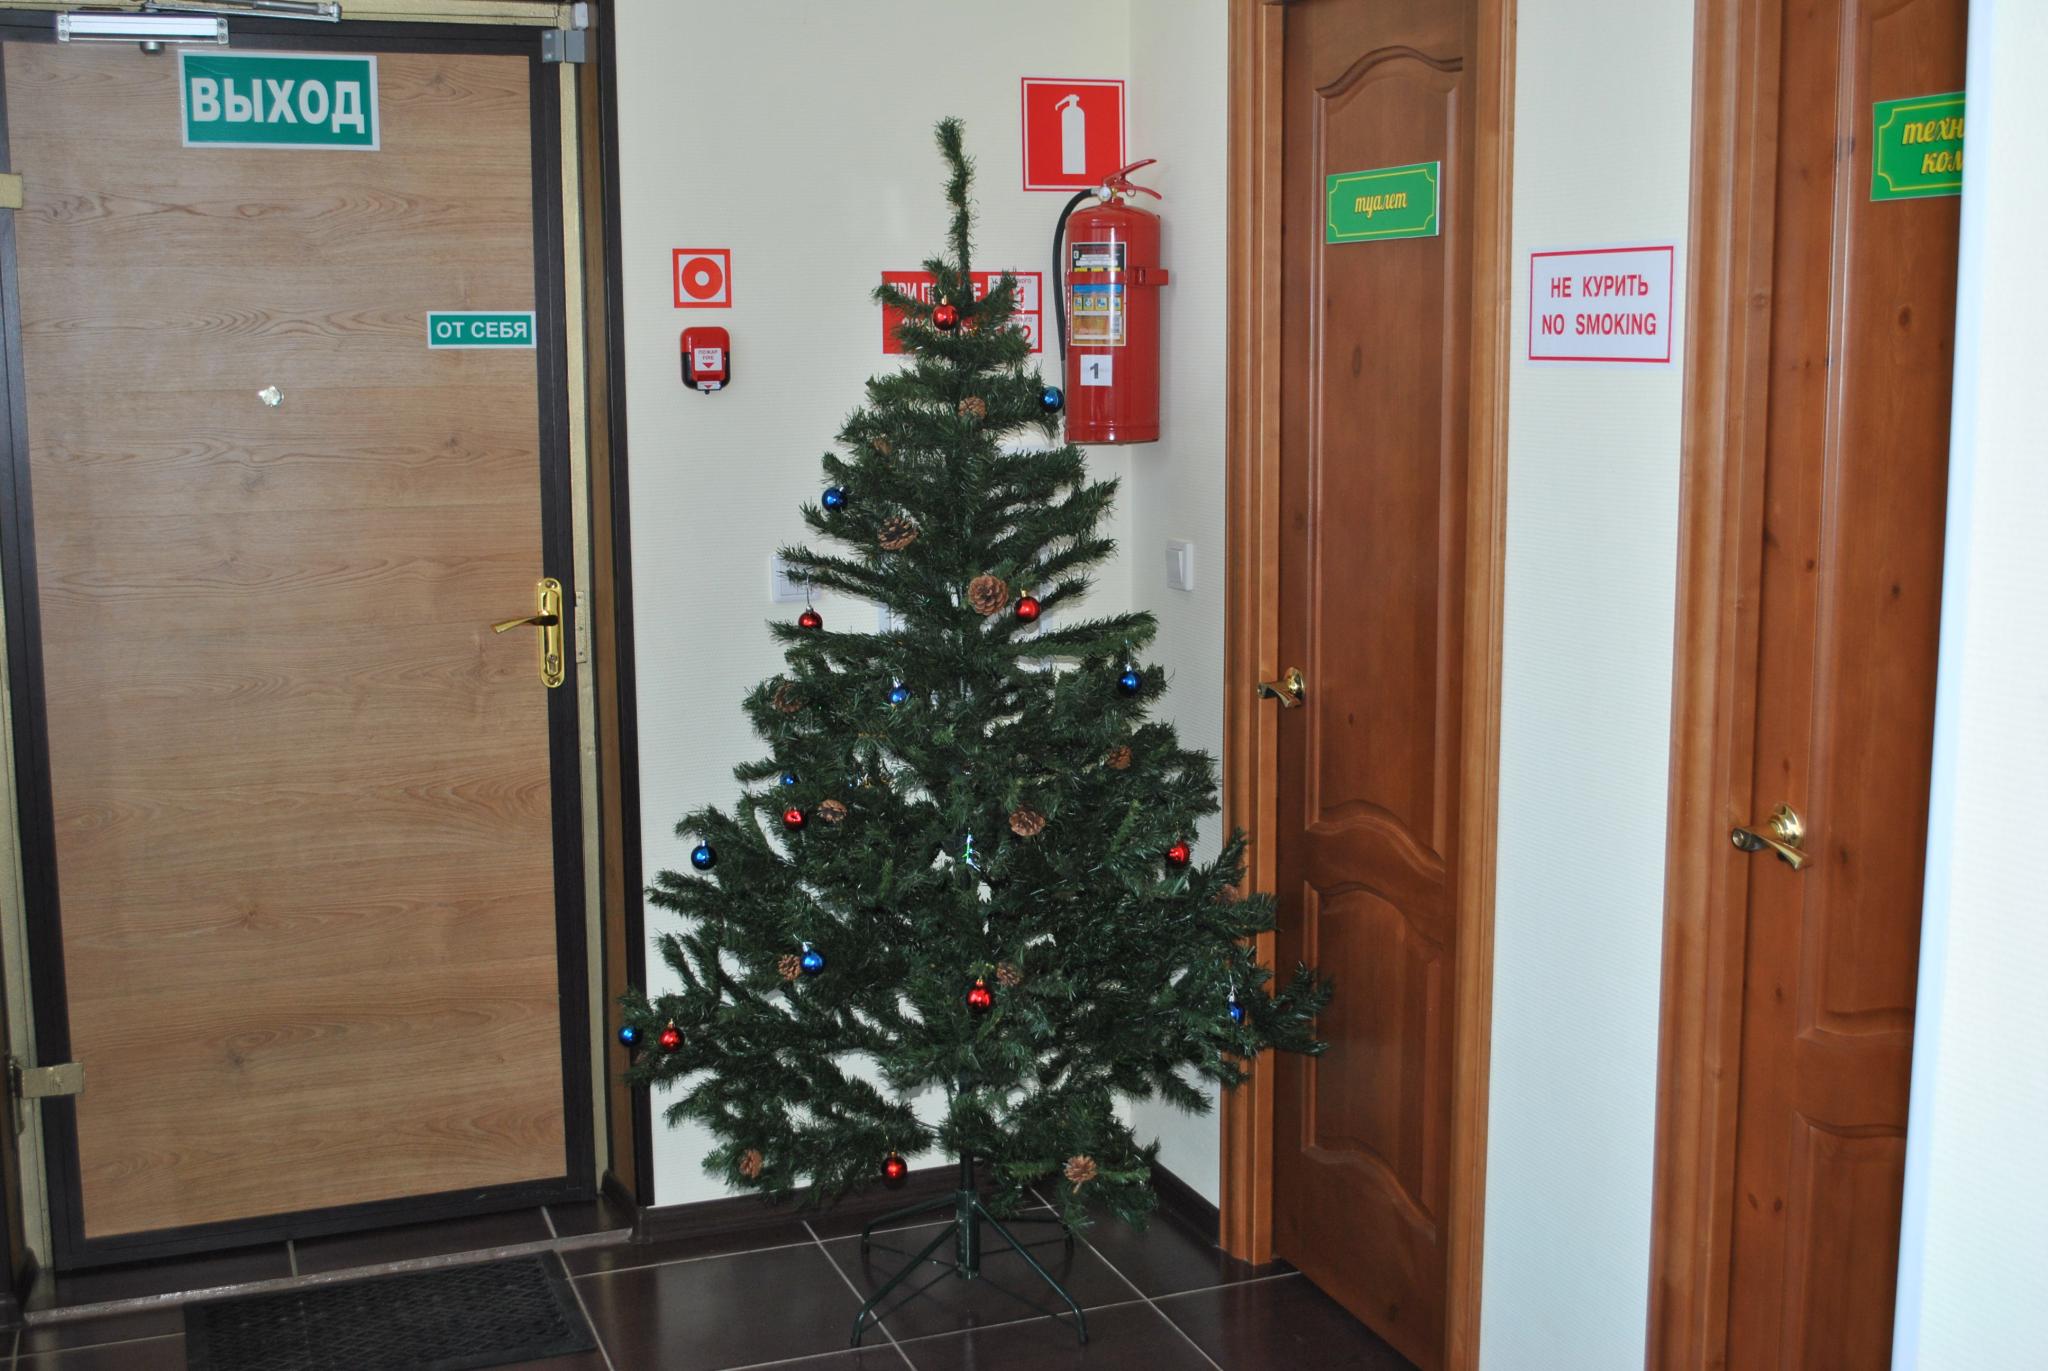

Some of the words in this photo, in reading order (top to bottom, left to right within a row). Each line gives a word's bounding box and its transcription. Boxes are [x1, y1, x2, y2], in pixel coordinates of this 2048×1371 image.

[191, 77, 365, 134] ВЫХОД
[1354, 192, 1408, 219] туалет
[1551, 277, 1572, 298] НЕ
[1582, 274, 1649, 298] КУРИТЬ
[436, 321, 465, 338] ОТ
[471, 321, 528, 338] СЕБЯ
[1541, 313, 1565, 336] NO
[1575, 312, 1657, 336] SMOKING
[1089, 362, 1099, 380] 1
